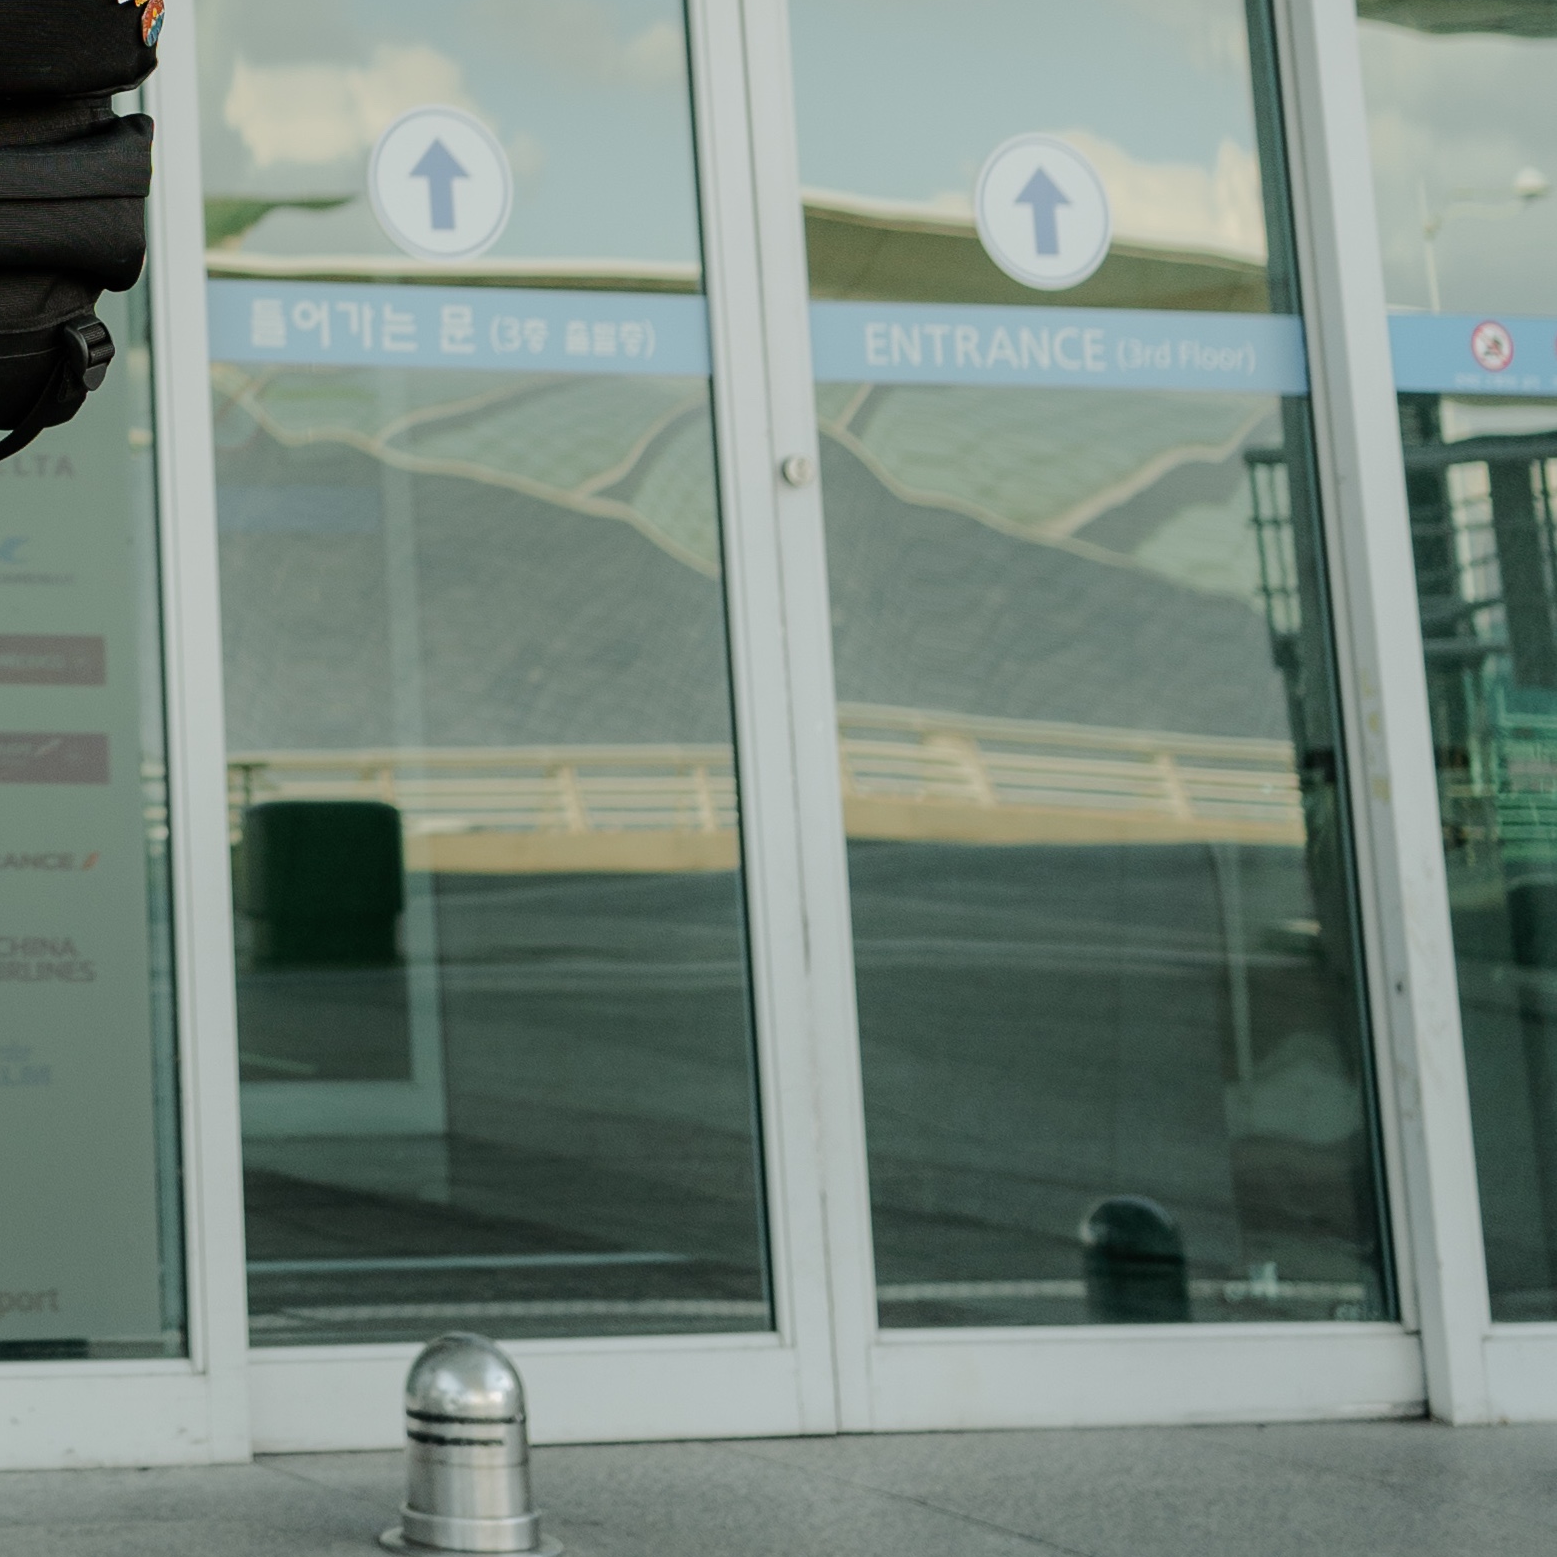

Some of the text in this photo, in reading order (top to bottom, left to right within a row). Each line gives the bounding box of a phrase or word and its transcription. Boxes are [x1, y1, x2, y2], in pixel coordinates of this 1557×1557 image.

[250, 298, 418, 354] 들어가는
[439, 303, 476, 354] 문
[864, 323, 1106, 373] ENTRANCE
